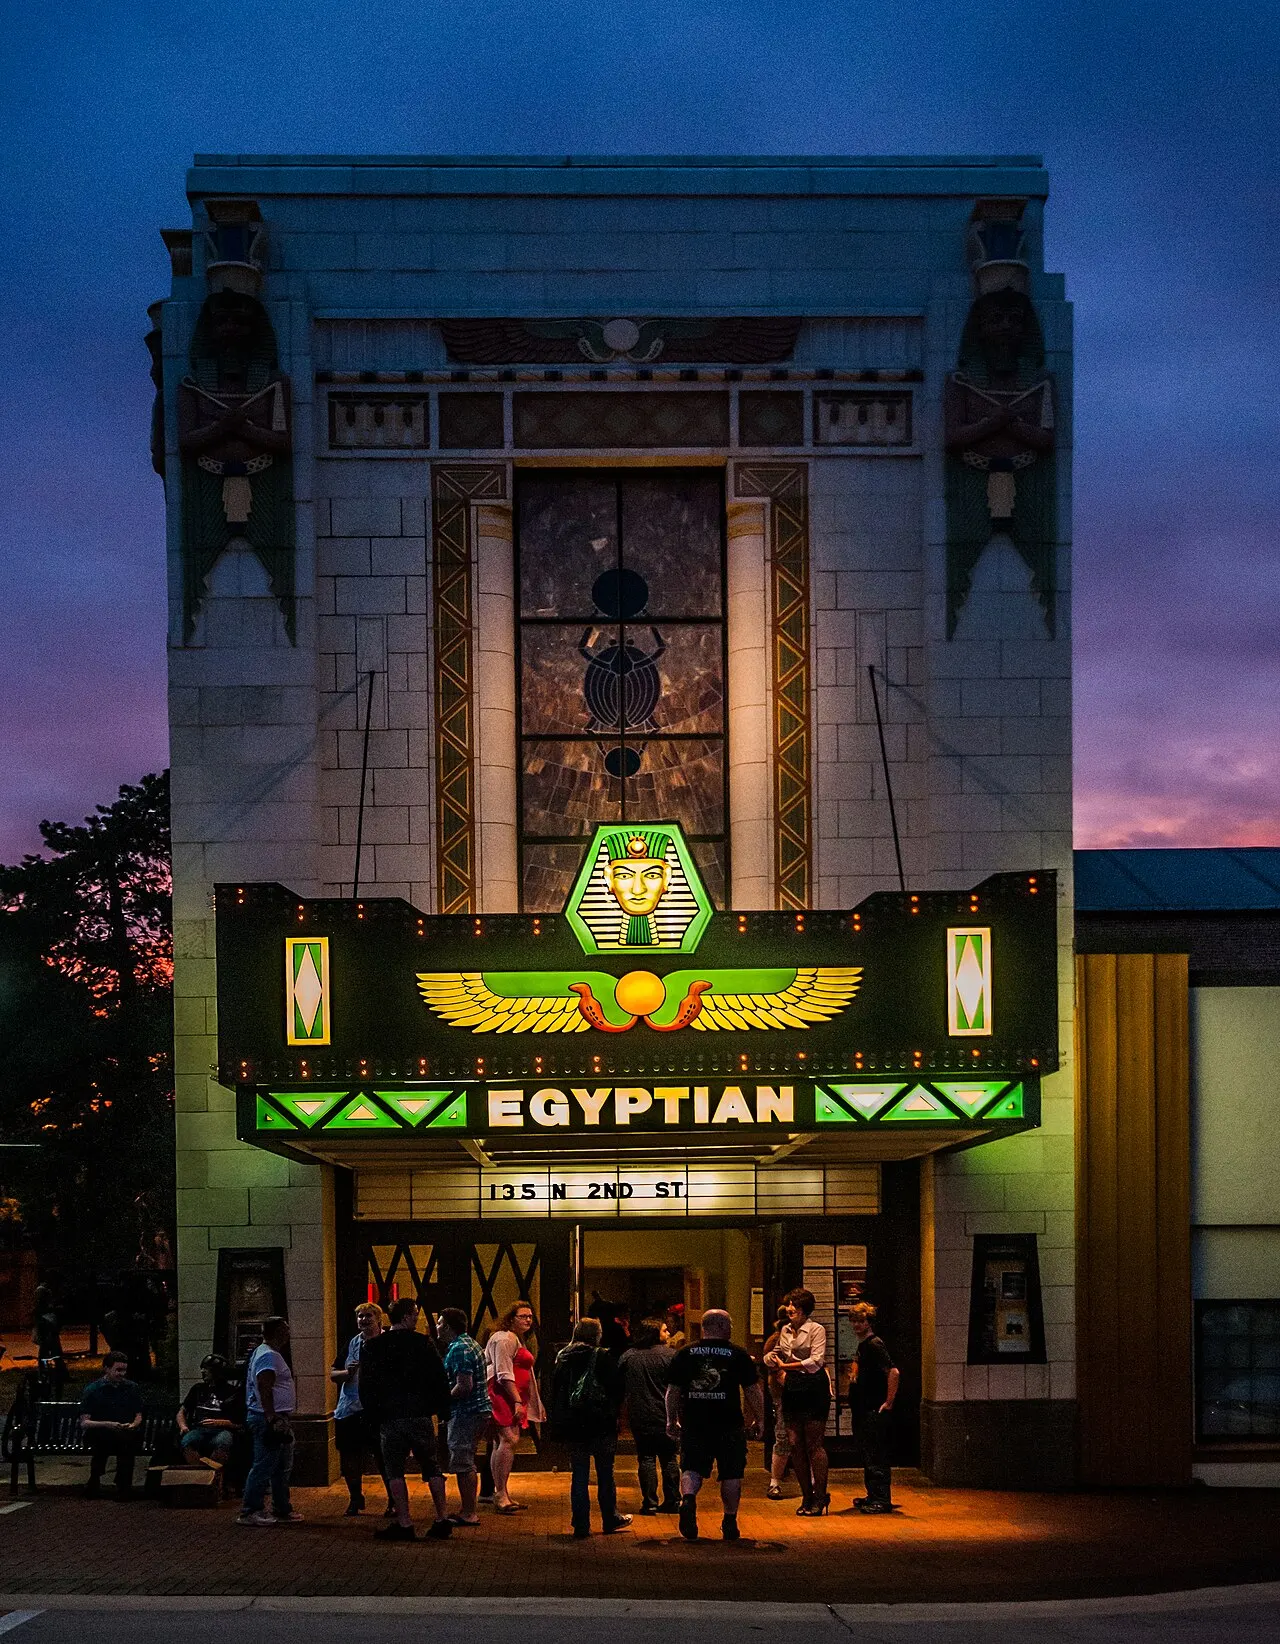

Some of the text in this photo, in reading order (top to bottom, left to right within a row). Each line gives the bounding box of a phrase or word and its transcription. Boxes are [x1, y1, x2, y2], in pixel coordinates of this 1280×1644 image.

[488, 1086, 794, 1127] EGYPTIAN
[490, 1184, 536, 1200] 135
[552, 1183, 567, 1200] N
[588, 1182, 633, 1199] 2ND
